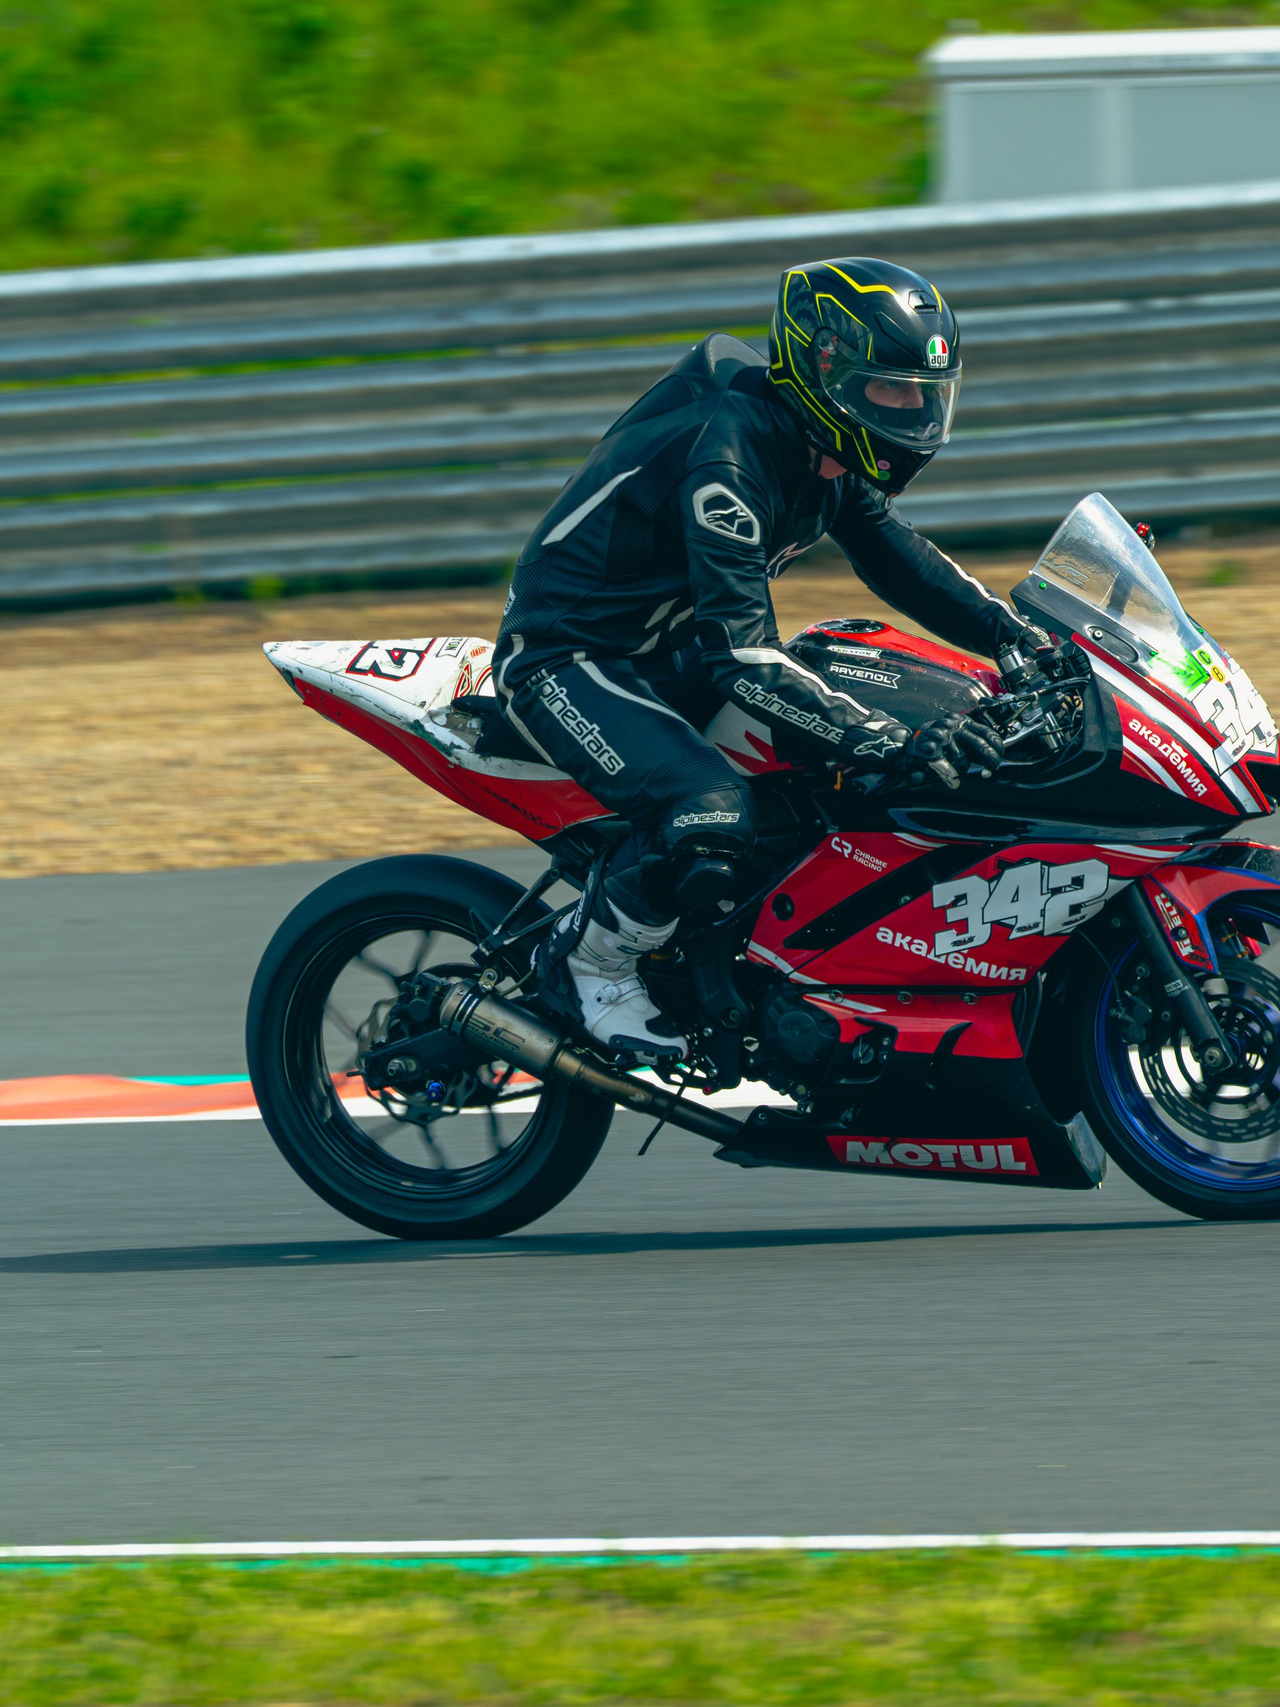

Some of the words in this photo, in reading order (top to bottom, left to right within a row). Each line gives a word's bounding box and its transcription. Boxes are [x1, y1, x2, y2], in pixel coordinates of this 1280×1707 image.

[829, 665, 892, 684] RAVENOL
[1128, 718, 1208, 797] академия
[673, 811, 740, 827] alpinestars
[852, 854, 883, 872] RACING
[854, 848, 888, 869] CHROME
[932, 857, 1110, 957] 342
[846, 1141, 1026, 1171] MOTUL
